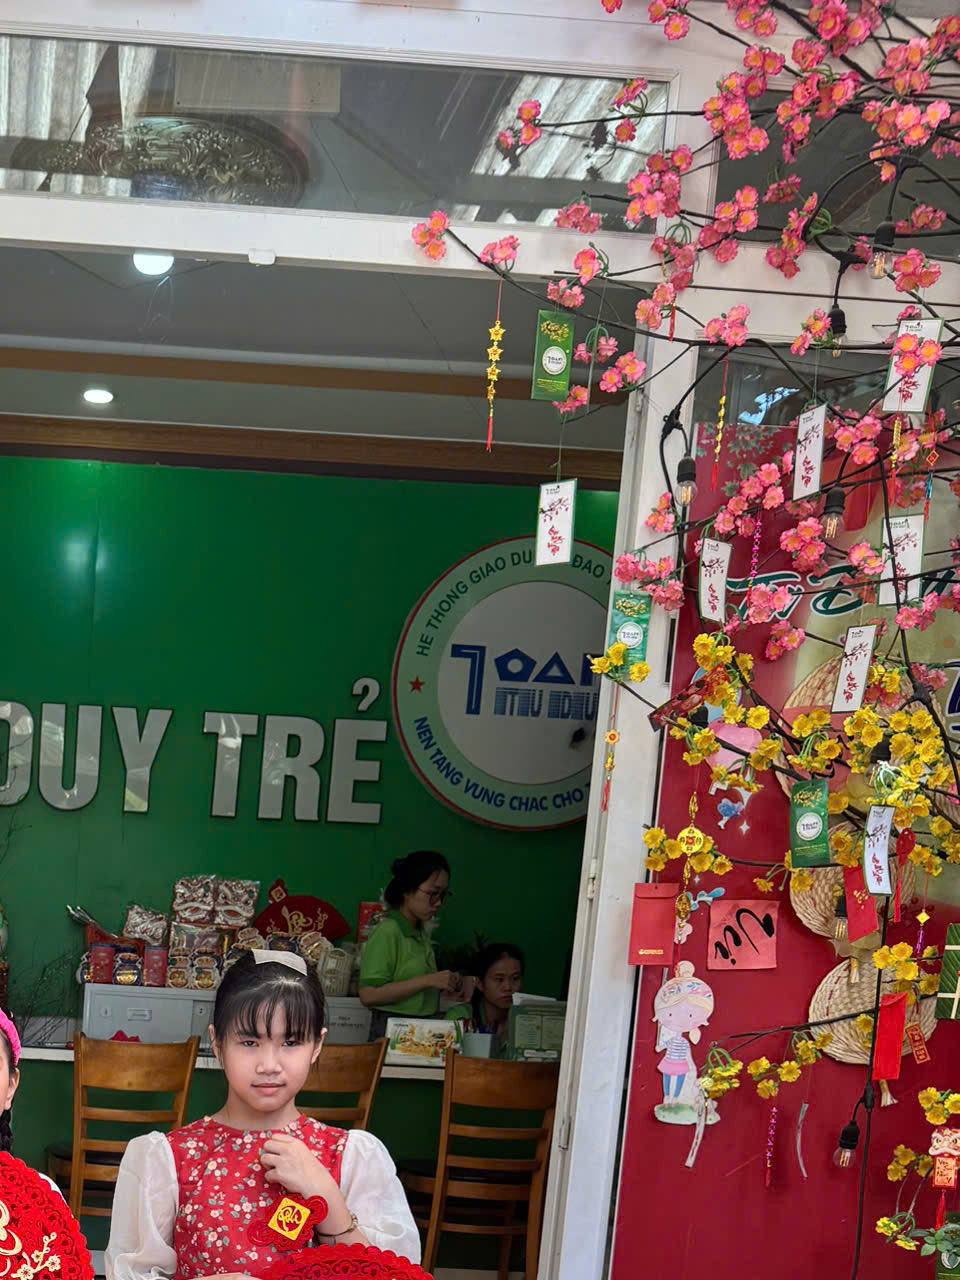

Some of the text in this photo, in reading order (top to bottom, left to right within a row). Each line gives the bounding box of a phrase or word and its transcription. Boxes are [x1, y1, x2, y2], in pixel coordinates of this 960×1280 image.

[468, 555, 507, 586] GIAO
[511, 550, 533, 567] DU
[203, 676, 388, 825] TRẺ
[552, 787, 585, 809] CHO
